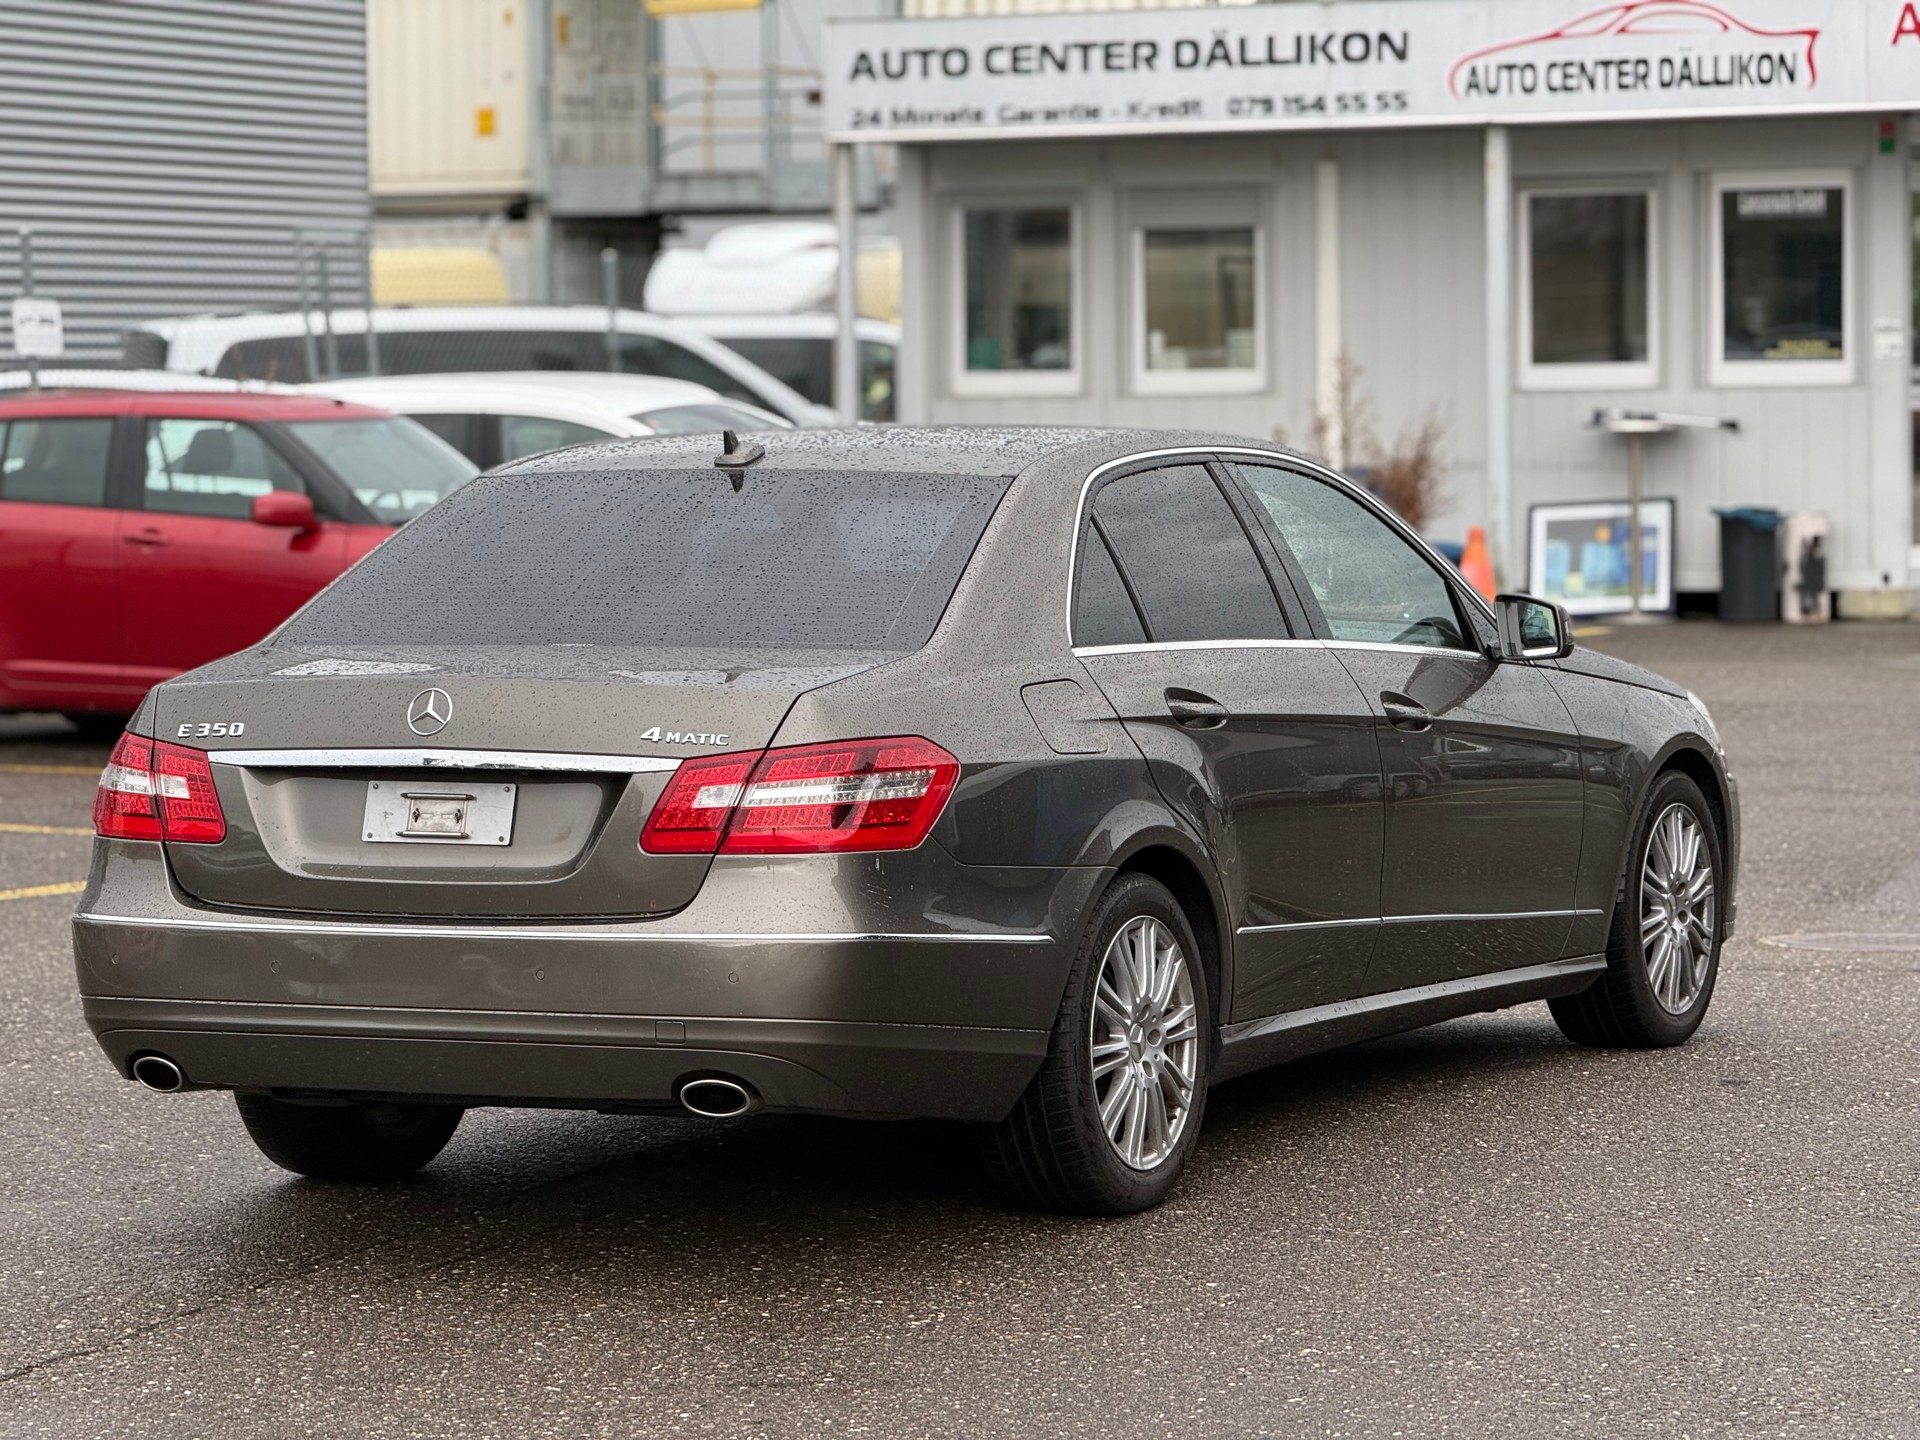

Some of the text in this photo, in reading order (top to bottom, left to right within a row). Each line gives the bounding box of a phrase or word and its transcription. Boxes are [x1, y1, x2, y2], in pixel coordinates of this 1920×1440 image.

[850, 30, 1409, 81] AUTO CENTER DÄLLIKON
[1465, 46, 1796, 96] AUTO CENTER DÄLLIKON
[177, 722, 245, 738] E 350
